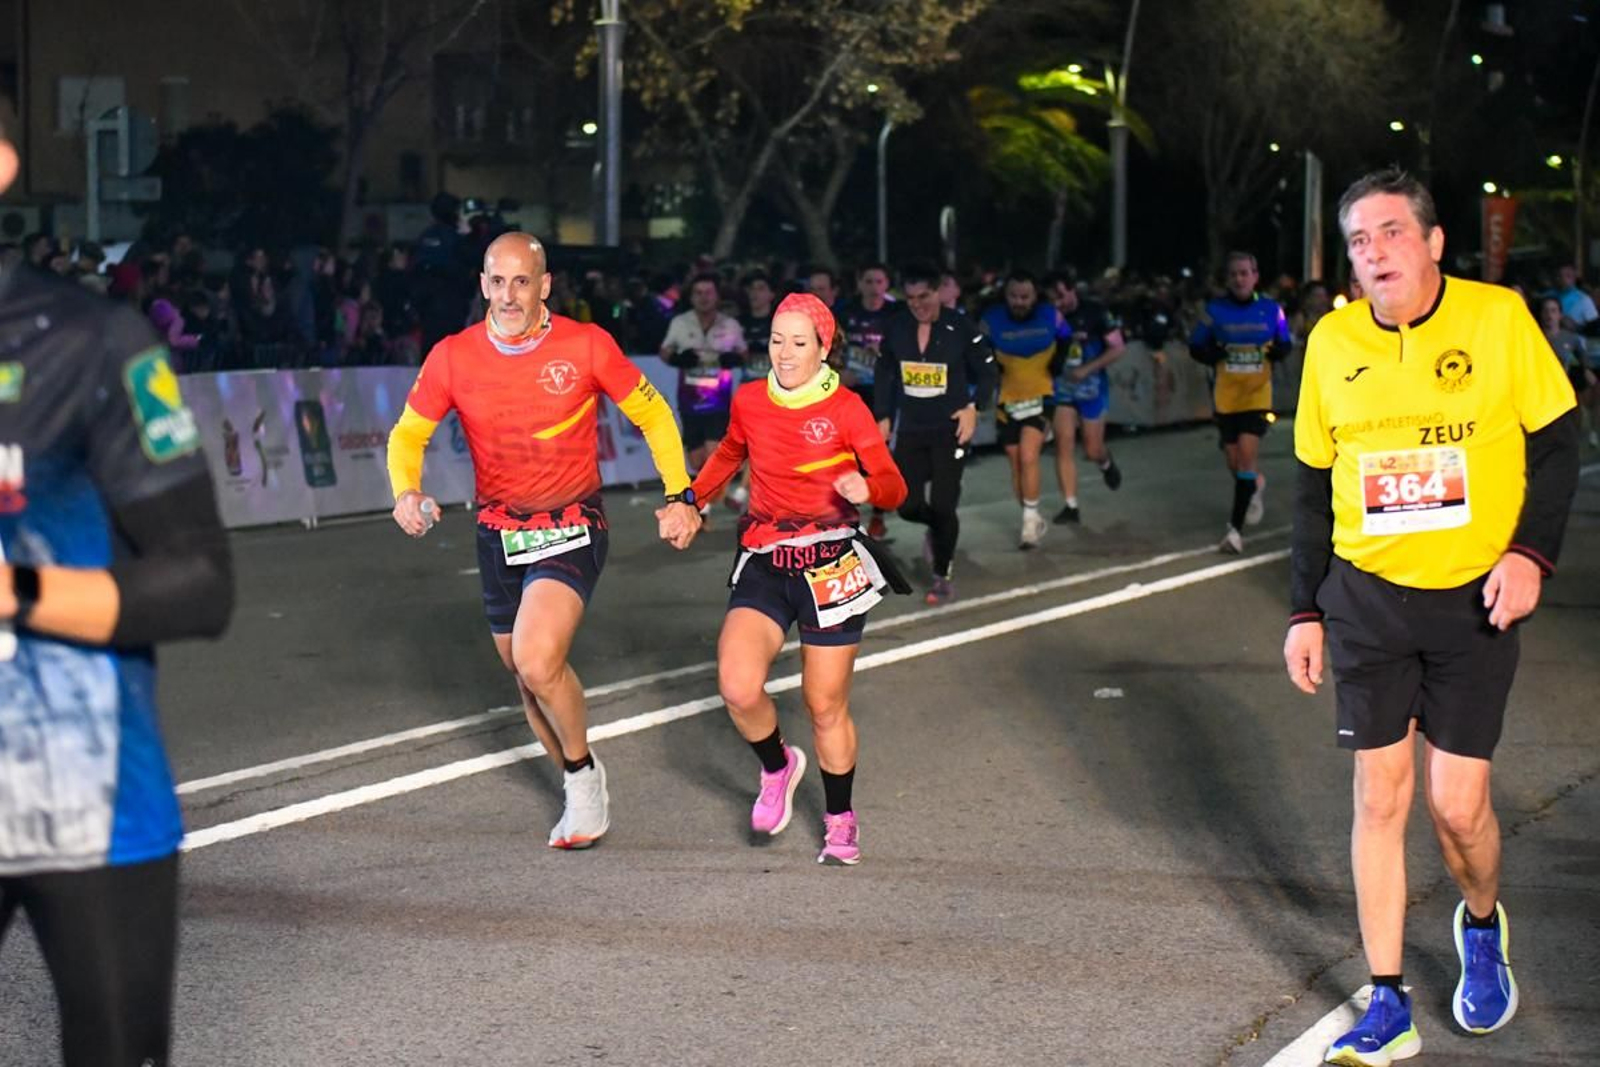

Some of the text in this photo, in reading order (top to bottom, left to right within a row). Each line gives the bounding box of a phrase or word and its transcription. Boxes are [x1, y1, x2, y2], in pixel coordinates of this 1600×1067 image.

[1343, 412, 1445, 434] CLUB ATLETISMO
[1418, 421, 1477, 445] ZEUS
[1377, 470, 1447, 504] 364
[772, 545, 816, 569] OTSO
[826, 565, 868, 604] 248
